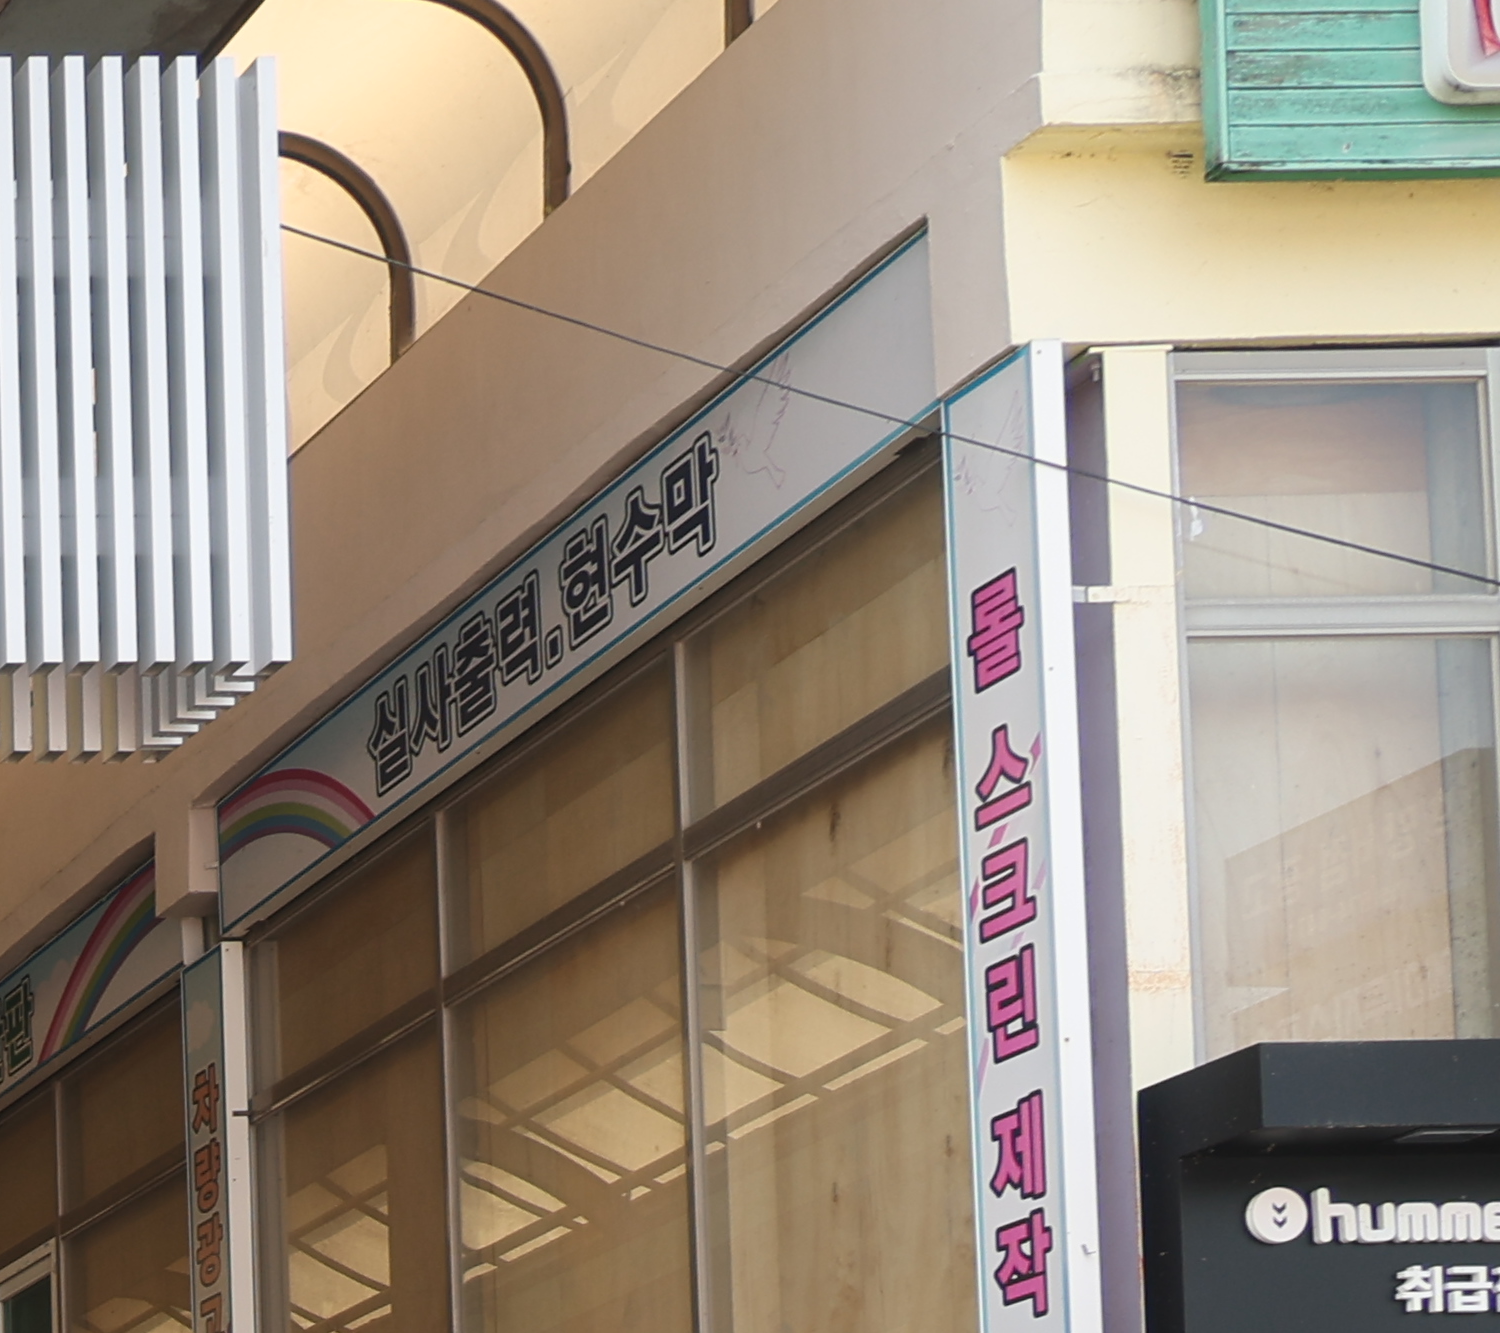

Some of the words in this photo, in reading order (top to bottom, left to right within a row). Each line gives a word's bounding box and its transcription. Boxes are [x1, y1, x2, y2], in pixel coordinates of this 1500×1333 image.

[968, 567, 1024, 692] 롤
[972, 724, 1040, 1061] 스크린
[990, 1092, 1052, 1317] 제작
